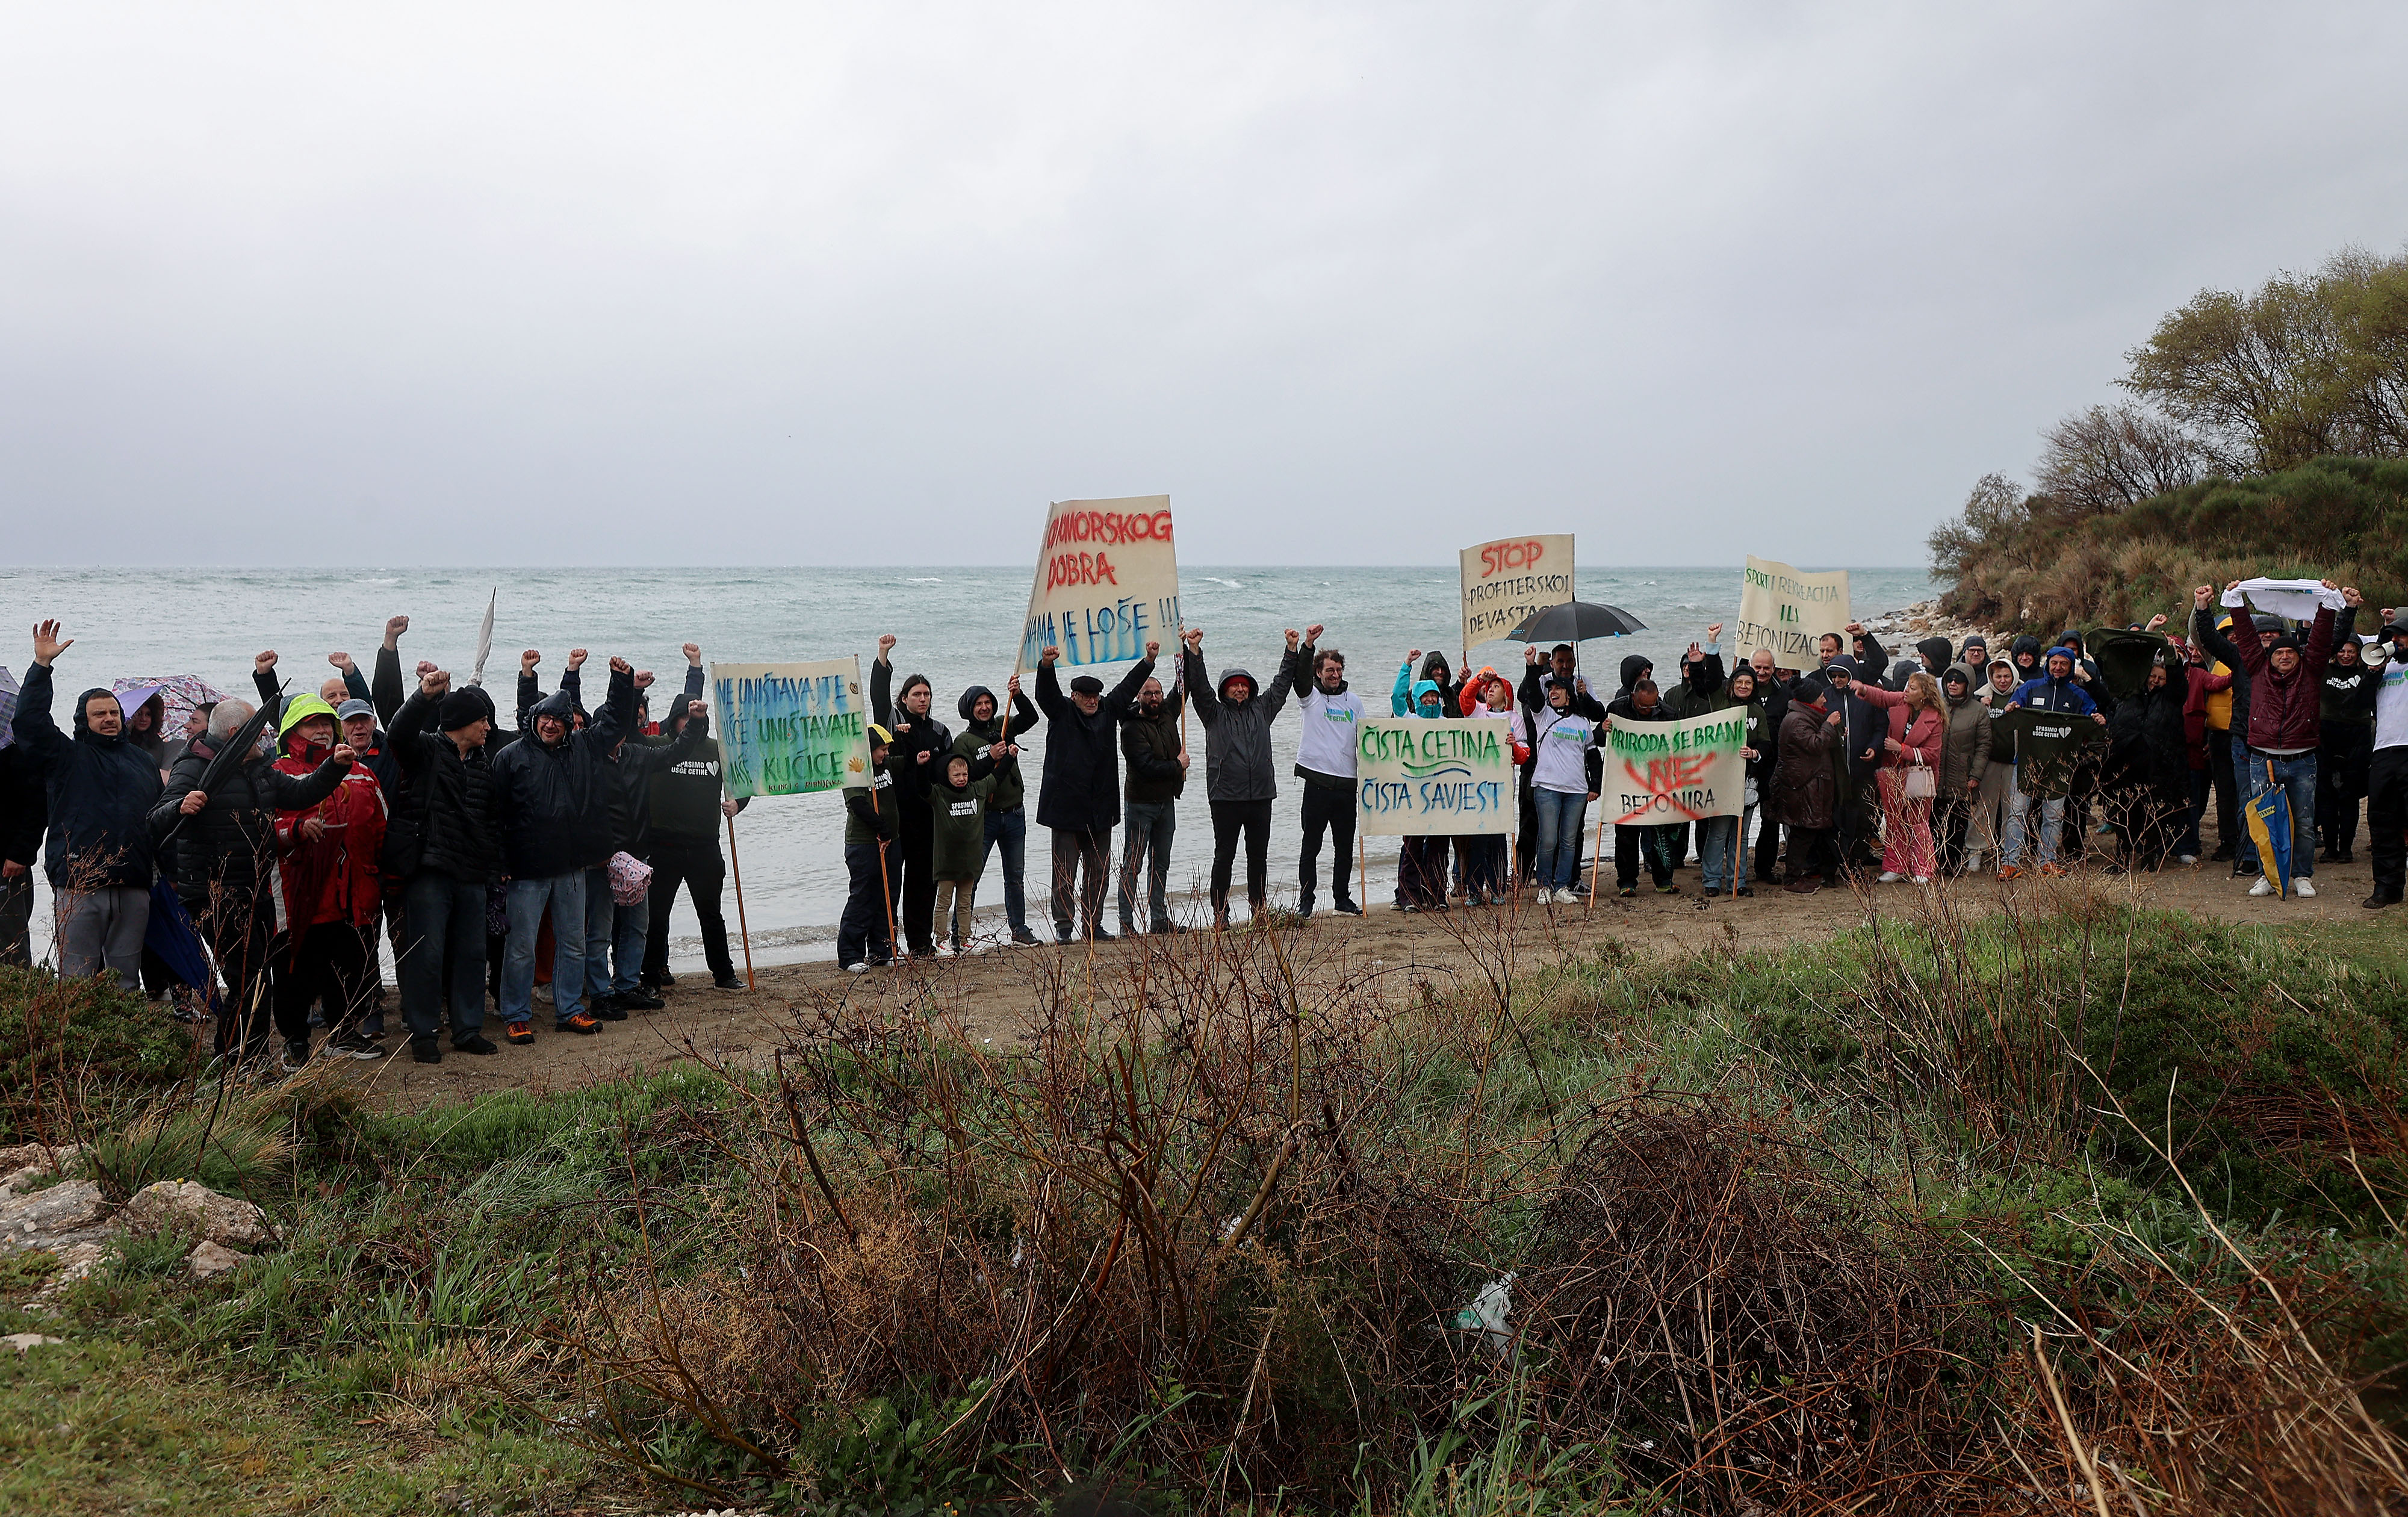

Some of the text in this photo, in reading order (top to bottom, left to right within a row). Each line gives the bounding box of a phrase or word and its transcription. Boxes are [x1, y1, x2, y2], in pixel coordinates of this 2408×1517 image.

[1047, 551, 1118, 591] DOBRA
[1481, 541, 1544, 578] STOP
[1469, 574, 1570, 606] PROFITERSKOJ
[1745, 568, 1840, 605] SPORT I REKREACIJA
[1025, 611, 1056, 644] NAMA
[1063, 610, 1076, 642] JE
[1086, 594, 1150, 636] LOŠE
[1780, 604, 1799, 622] ILI
[1736, 618, 1821, 656] BETONIZAC
[716, 671, 847, 707] NE UNIŠTAVAJTE
[758, 710, 862, 745] UNIŠTAVATE
[1361, 725, 1501, 760] ČISTA CETINA
[1611, 727, 1670, 753] PRIRODA
[1672, 728, 1690, 753] SE
[1694, 718, 1743, 747] BRANI
[978, 744, 991, 754] SPASI
[1361, 777, 1505, 816] ČISTA SAVJEST
[1620, 788, 1716, 816] BETONIRA
